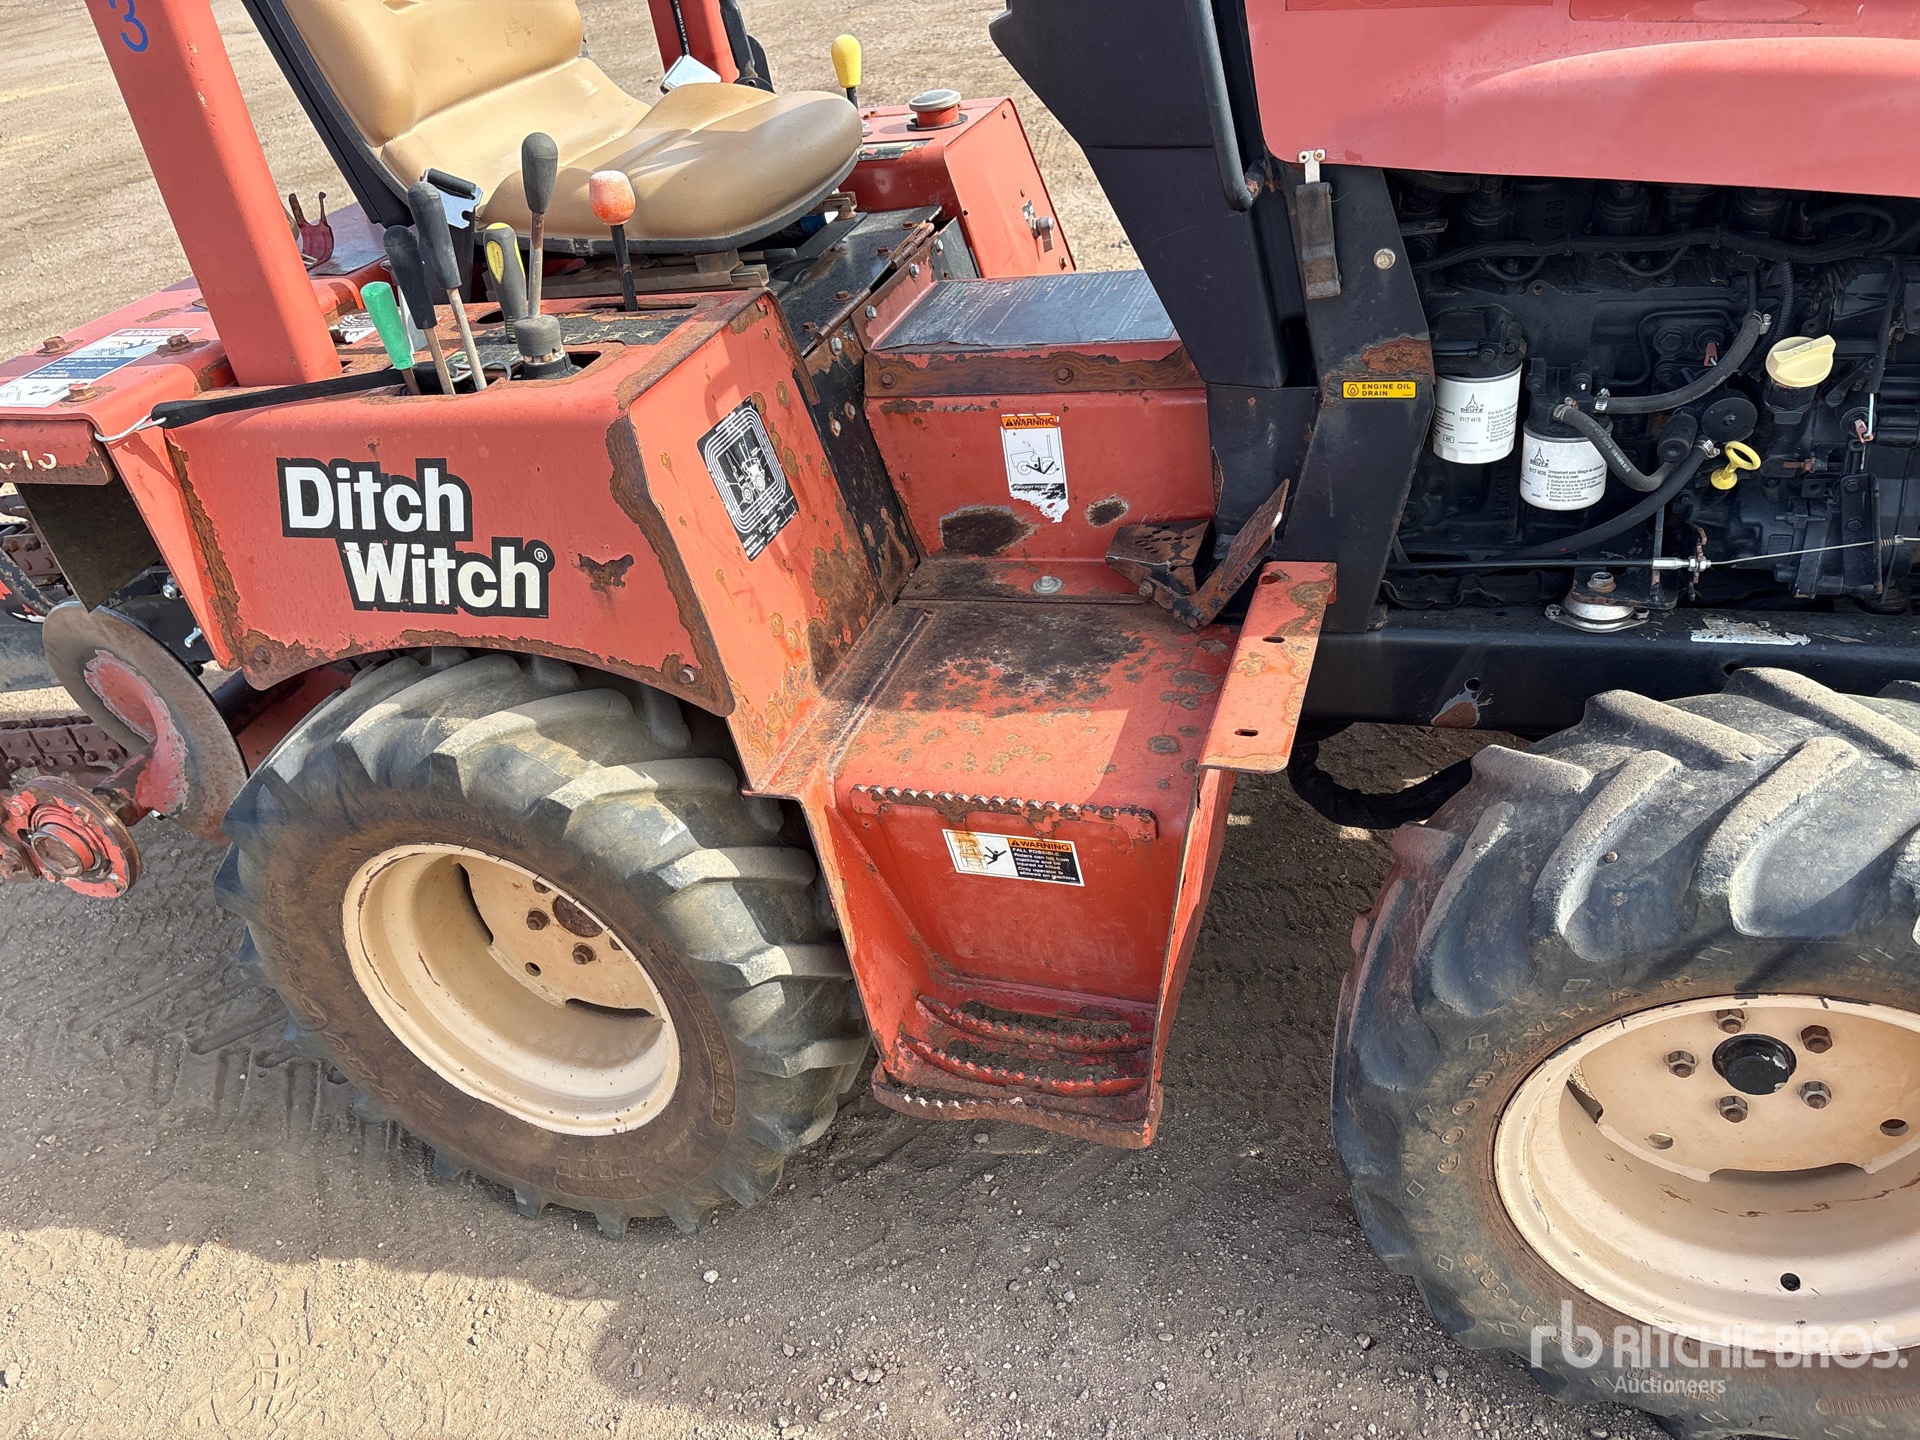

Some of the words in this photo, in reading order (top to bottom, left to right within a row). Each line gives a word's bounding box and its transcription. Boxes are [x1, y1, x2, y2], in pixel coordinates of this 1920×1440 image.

[1013, 417, 1057, 427] WARNING
[285, 466, 465, 533] Ditch
[343, 542, 541, 609] Witch
[1020, 840, 1070, 851] WARNING
[1436, 974, 1694, 1174] GOODYEAR
